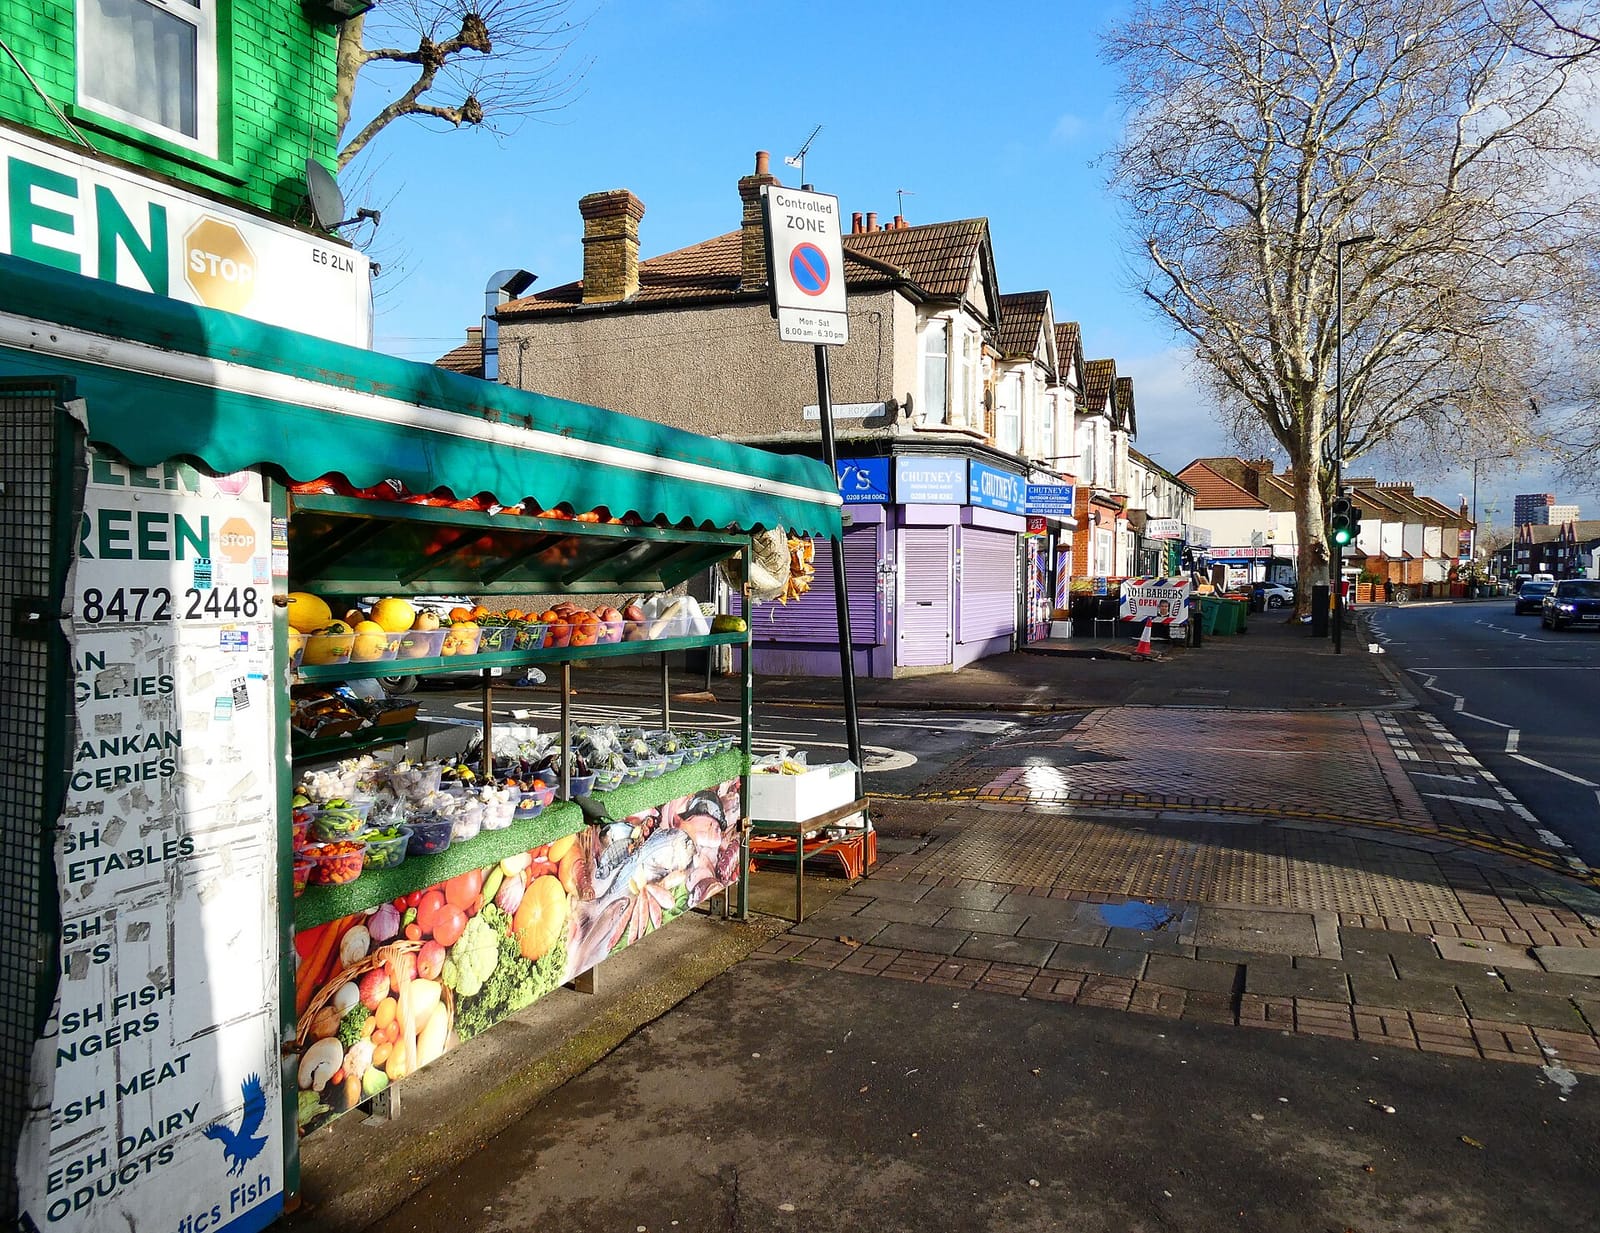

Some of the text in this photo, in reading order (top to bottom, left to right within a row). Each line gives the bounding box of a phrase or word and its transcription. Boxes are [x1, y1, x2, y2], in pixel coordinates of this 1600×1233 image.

[776, 195, 832, 214] Controlled
[786, 214, 826, 234] ZONE
[190, 251, 253, 284] STOP
[312, 248, 354, 273] E6 2LN
[785, 327, 802, 336] 8.00
[817, 330, 833, 338] 6.30
[799, 317, 813, 326] Mon
[818, 319, 830, 327] Sat
[901, 471, 962, 484] CHUTNEY'S
[1028, 486, 1071, 495] CHUTNEY'S
[220, 534, 255, 547] STOP
[83, 587, 258, 623] 8472 2448
[1146, 588, 1183, 599] BARBERS
[76, 729, 182, 762] ANKAN
[70, 758, 176, 792] CERIES
[69, 836, 195, 884] ETABLES
[63, 916, 101, 944] SH
[61, 977, 176, 1034] SH FISH
[56, 1012, 160, 1068] NGERS
[116, 1053, 191, 1101] MEAT
[47, 1102, 200, 1195] ESH DAIRY
[46, 1144, 174, 1223] ODUCTS
[230, 1173, 271, 1214] Fish
